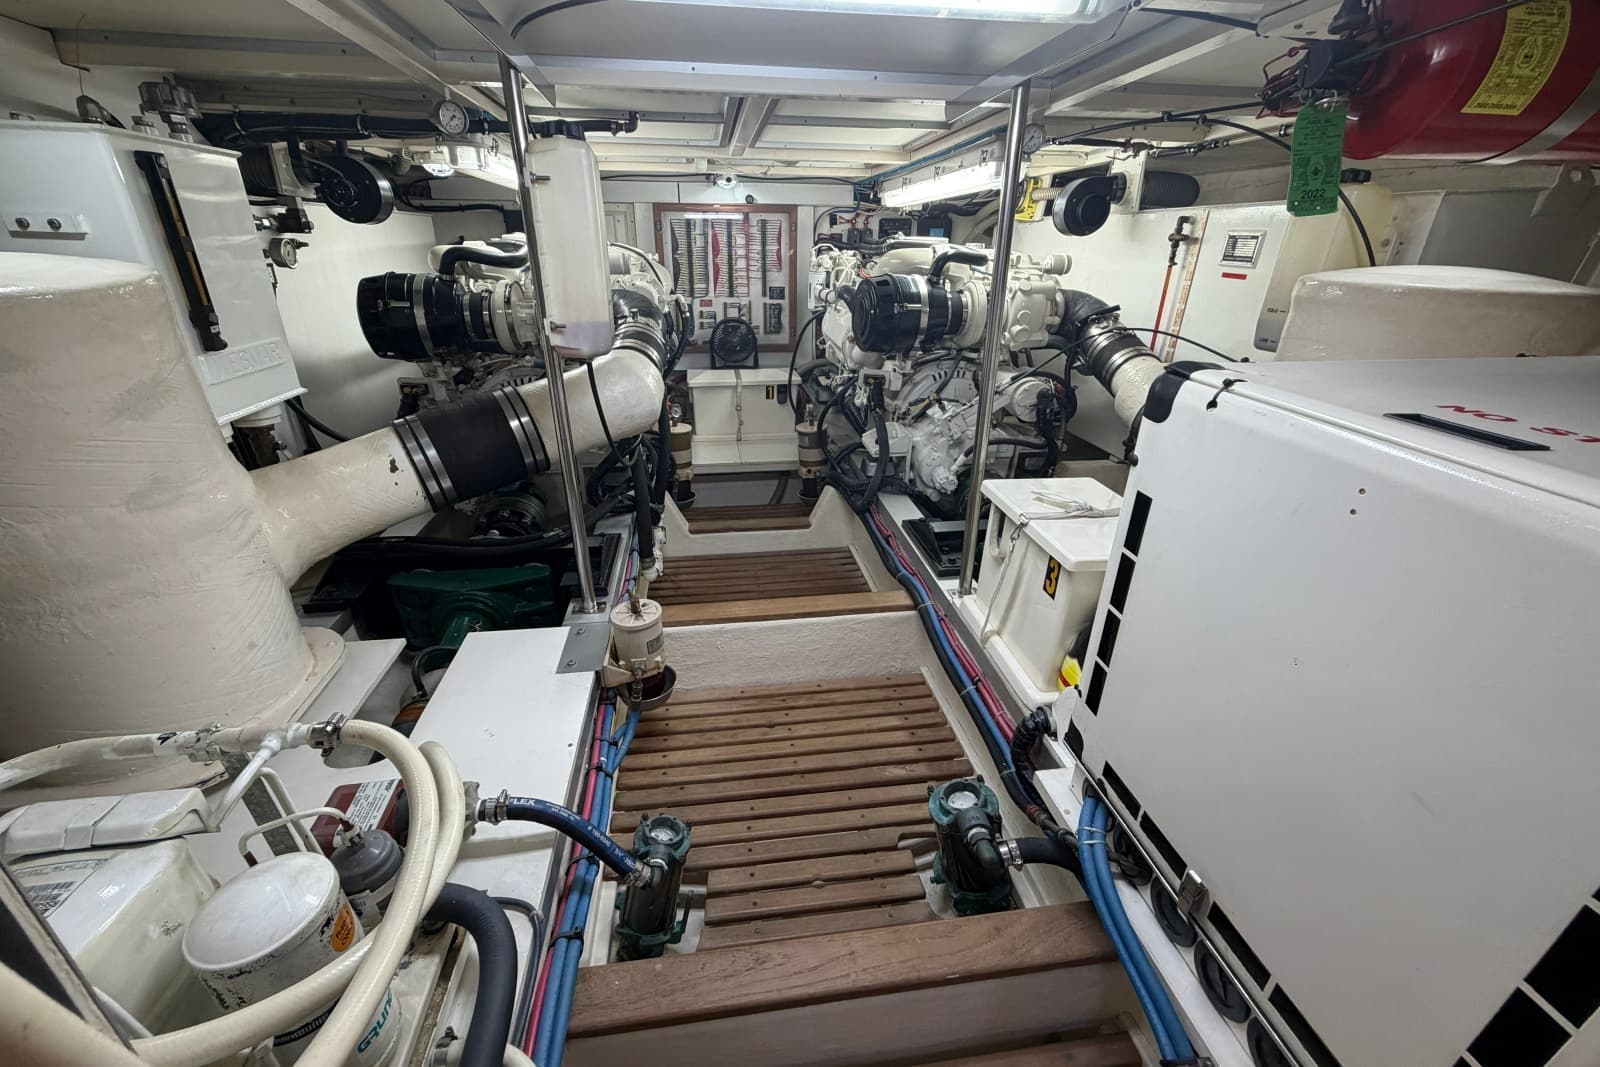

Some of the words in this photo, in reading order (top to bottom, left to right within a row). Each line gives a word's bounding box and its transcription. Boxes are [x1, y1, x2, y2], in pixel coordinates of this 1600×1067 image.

[1301, 188, 1327, 200] 2022
[1435, 405, 1518, 422] NO
[1045, 558, 1060, 595] 3
